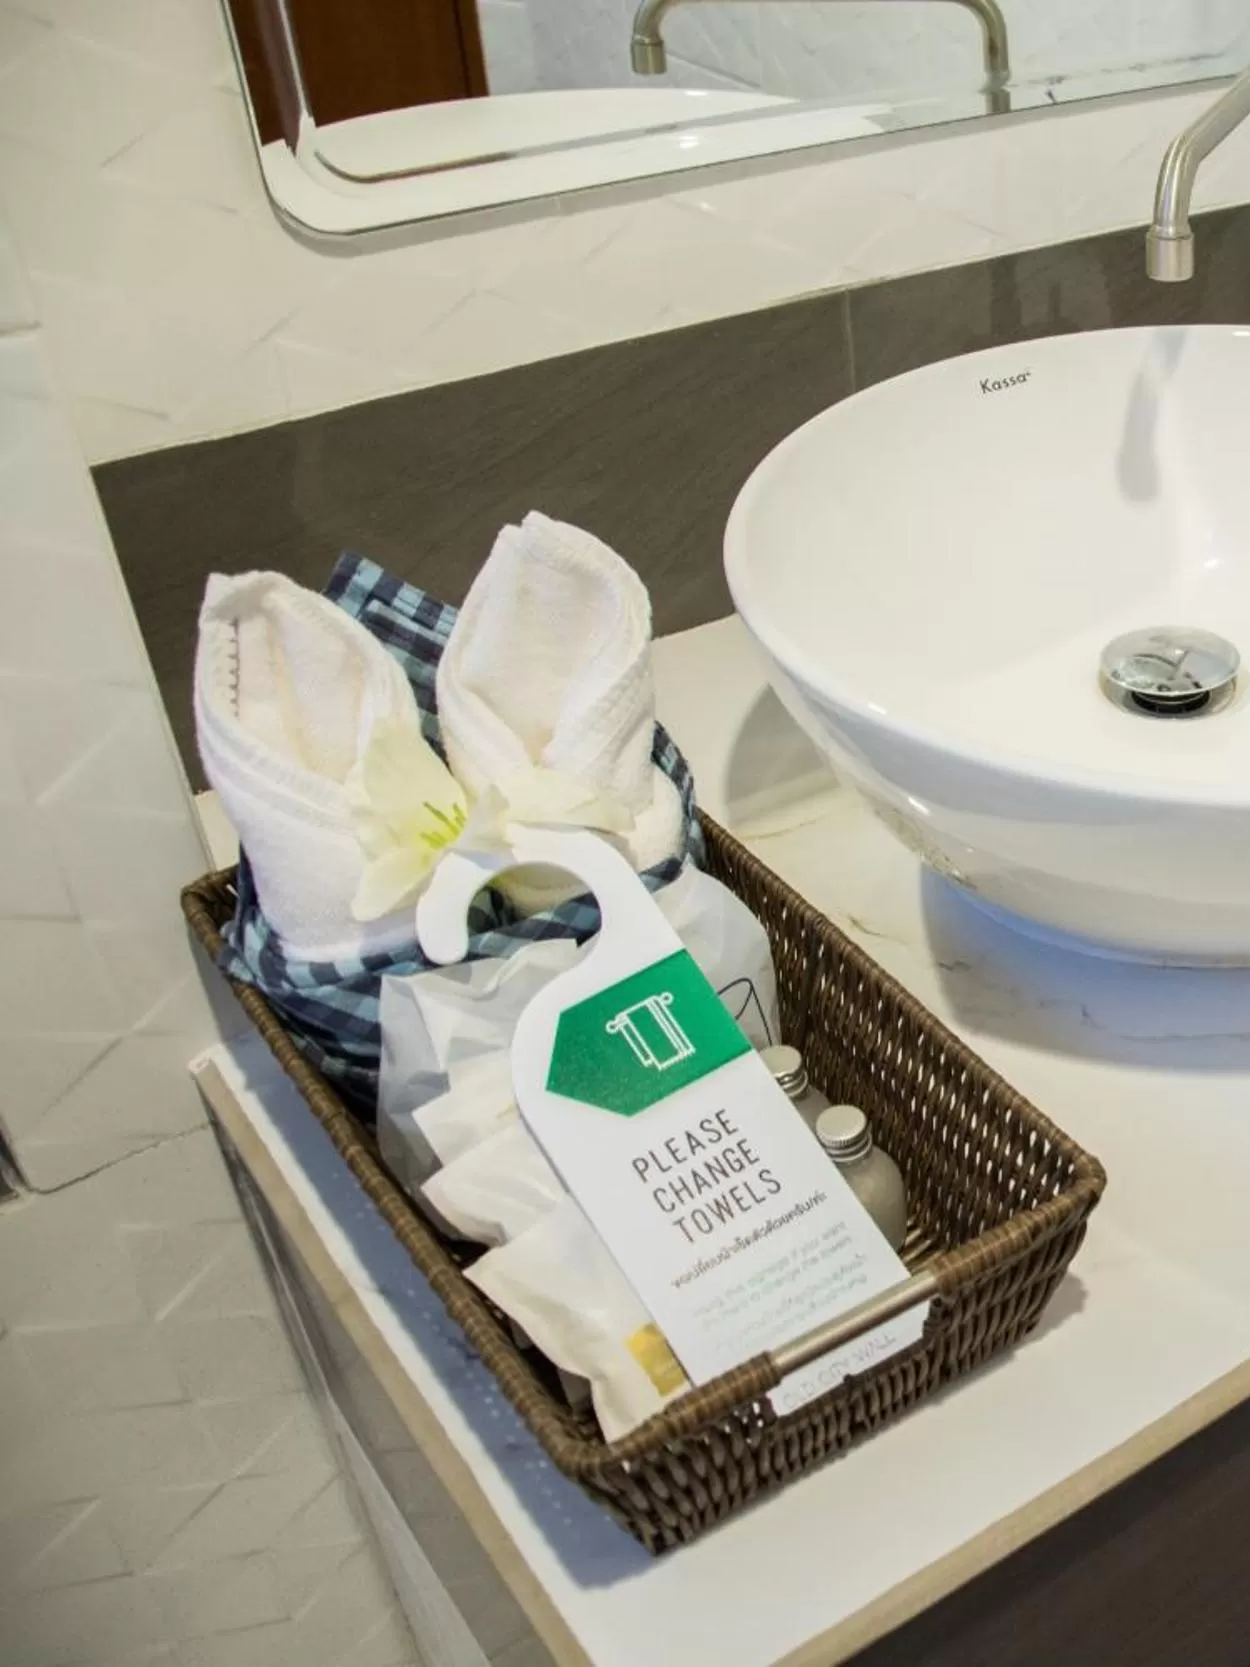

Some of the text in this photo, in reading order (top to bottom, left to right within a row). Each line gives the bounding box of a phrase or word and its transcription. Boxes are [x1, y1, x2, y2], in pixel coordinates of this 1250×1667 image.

[980, 372, 1028, 394] Kassa
[631, 1108, 738, 1183] PLEASE
[652, 1138, 760, 1213] CHANGE
[672, 1168, 782, 1244] TOWELS
